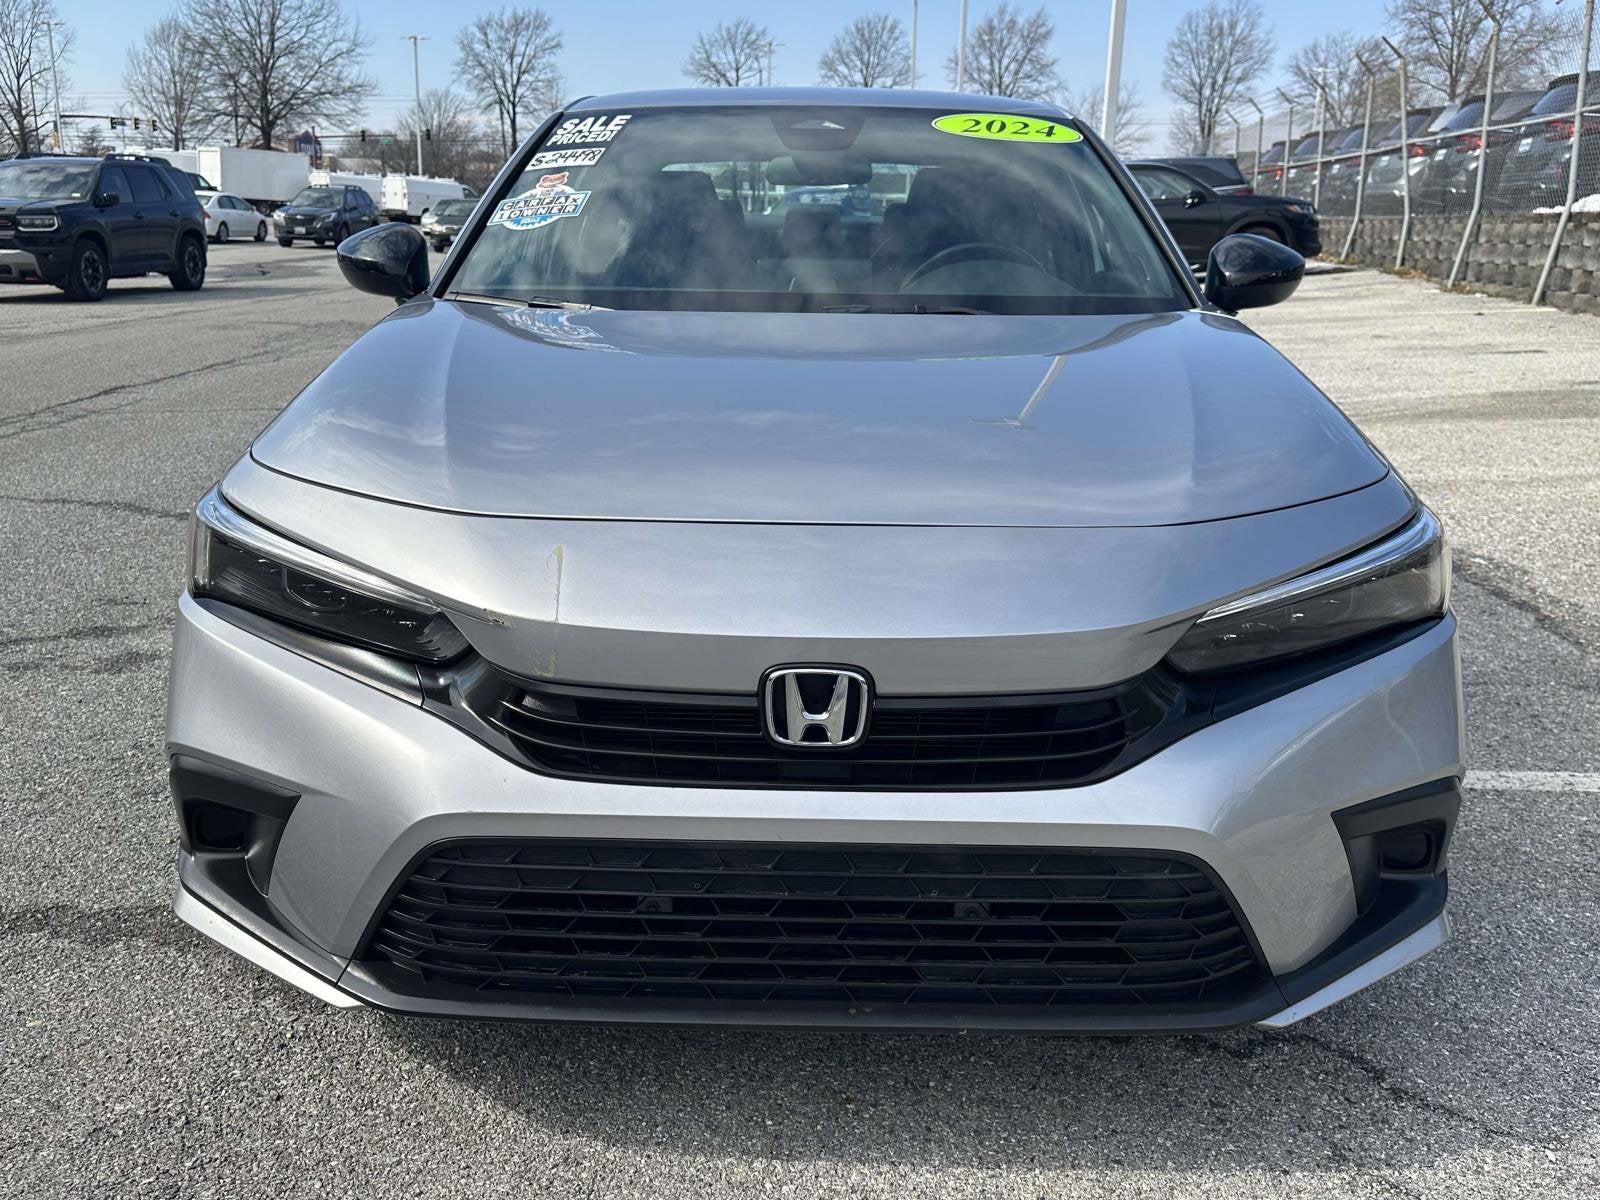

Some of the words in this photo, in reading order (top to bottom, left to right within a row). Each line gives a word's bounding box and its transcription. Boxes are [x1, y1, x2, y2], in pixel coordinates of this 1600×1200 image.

[556, 114, 632, 135] SALE
[962, 119, 1057, 137] 2024
[546, 130, 618, 147] PRICED!
[503, 196, 580, 210] CARFAX
[510, 206, 575, 218] OWNER
